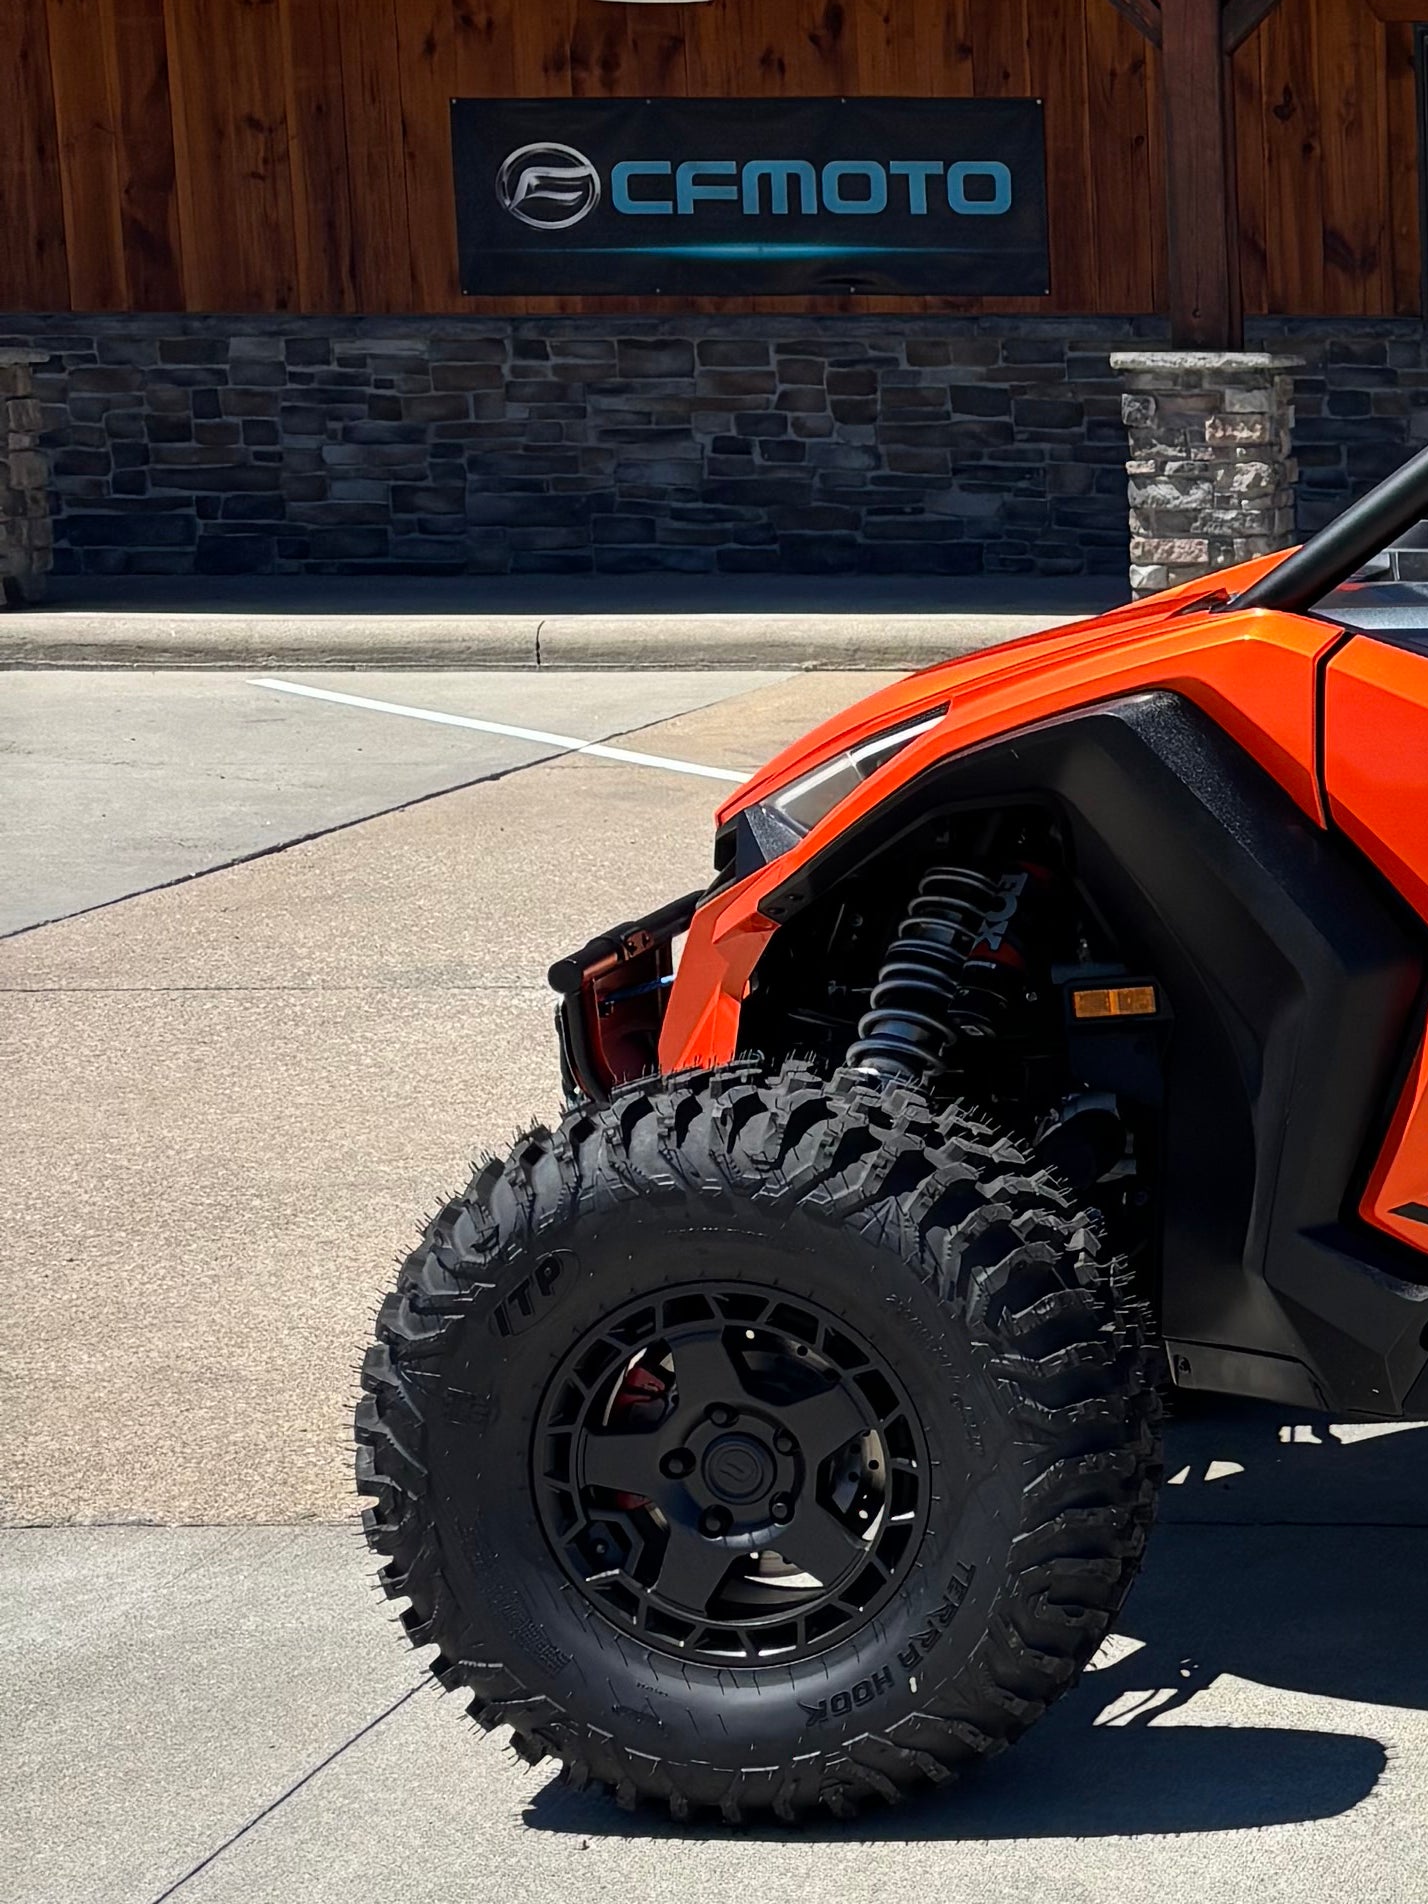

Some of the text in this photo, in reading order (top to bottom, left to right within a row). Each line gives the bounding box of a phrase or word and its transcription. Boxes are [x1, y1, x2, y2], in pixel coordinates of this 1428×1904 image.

[611, 159, 1012, 216] CFMOTO
[494, 1256, 562, 1338] ITP
[798, 1560, 977, 1727] TERRA HOOK
